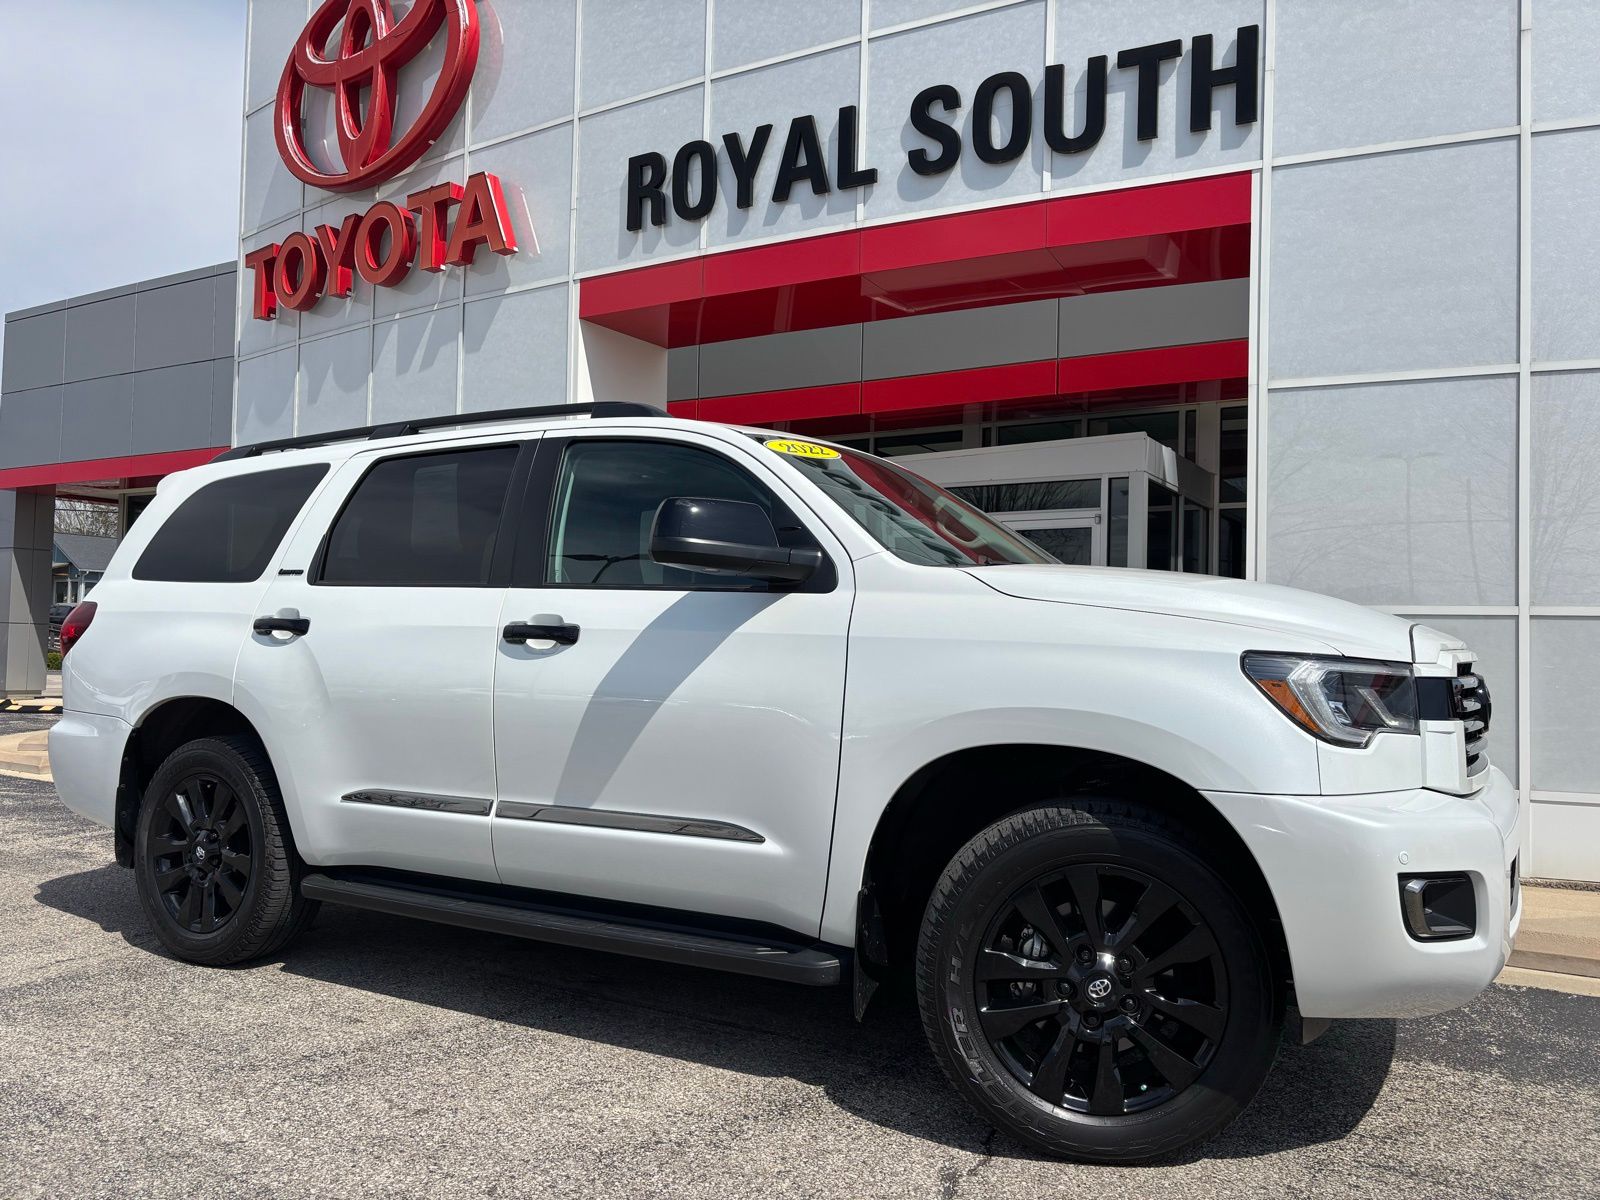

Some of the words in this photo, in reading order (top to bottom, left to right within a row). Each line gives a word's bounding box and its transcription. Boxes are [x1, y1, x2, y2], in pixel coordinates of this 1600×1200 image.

[627, 105, 877, 231] ROYAL
[908, 24, 1258, 175] SOUTH
[245, 171, 518, 321] TOYOTA
[778, 443, 831, 455] 2022
